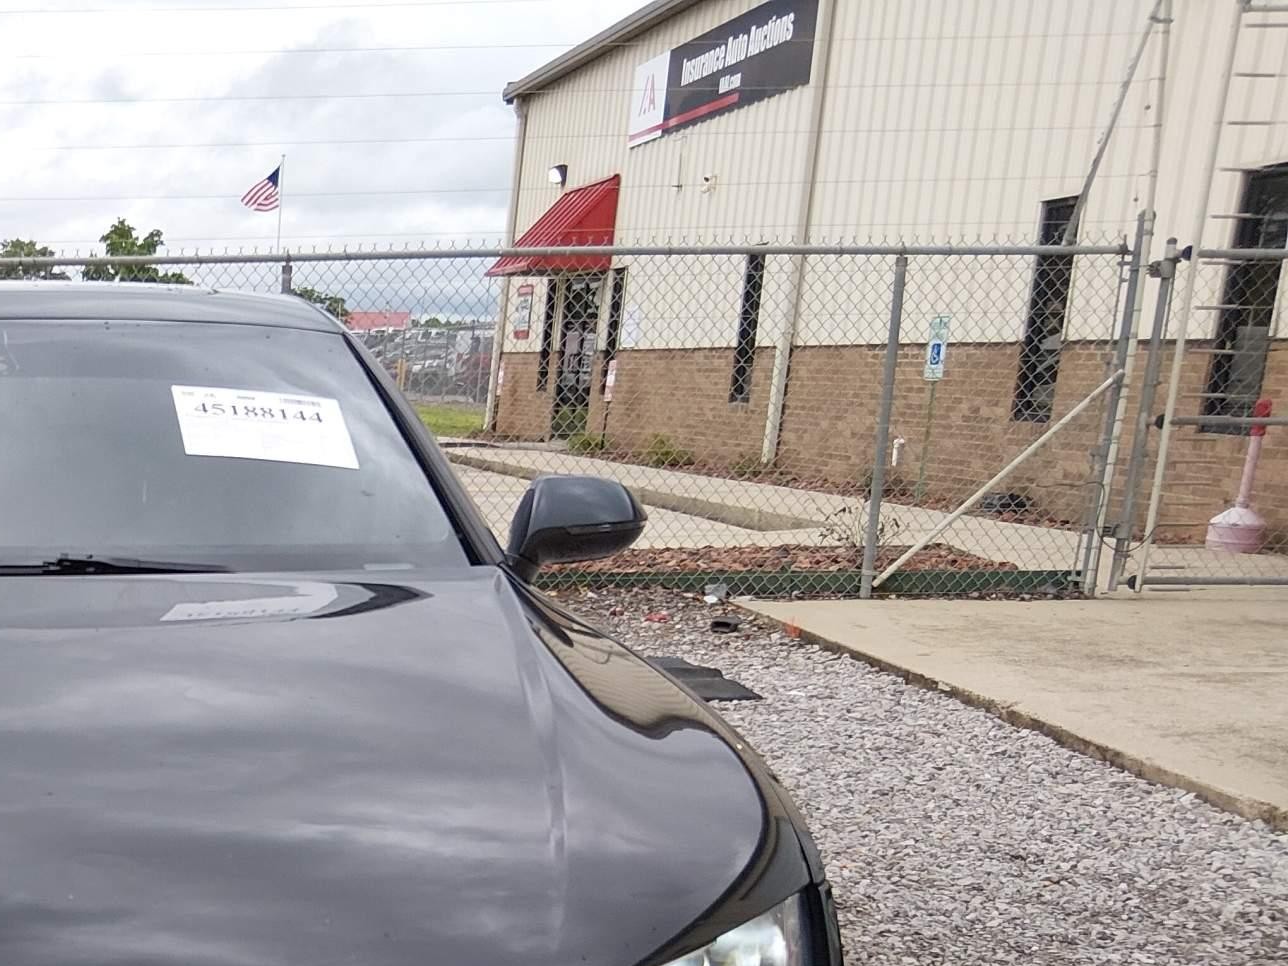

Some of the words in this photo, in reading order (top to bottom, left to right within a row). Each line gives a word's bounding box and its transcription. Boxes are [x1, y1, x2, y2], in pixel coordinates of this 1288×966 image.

[680, 44, 726, 86] Insurance
[725, 33, 748, 67] Auto
[747, 12, 795, 58] Auctions
[194, 402, 323, 423] 45188144
